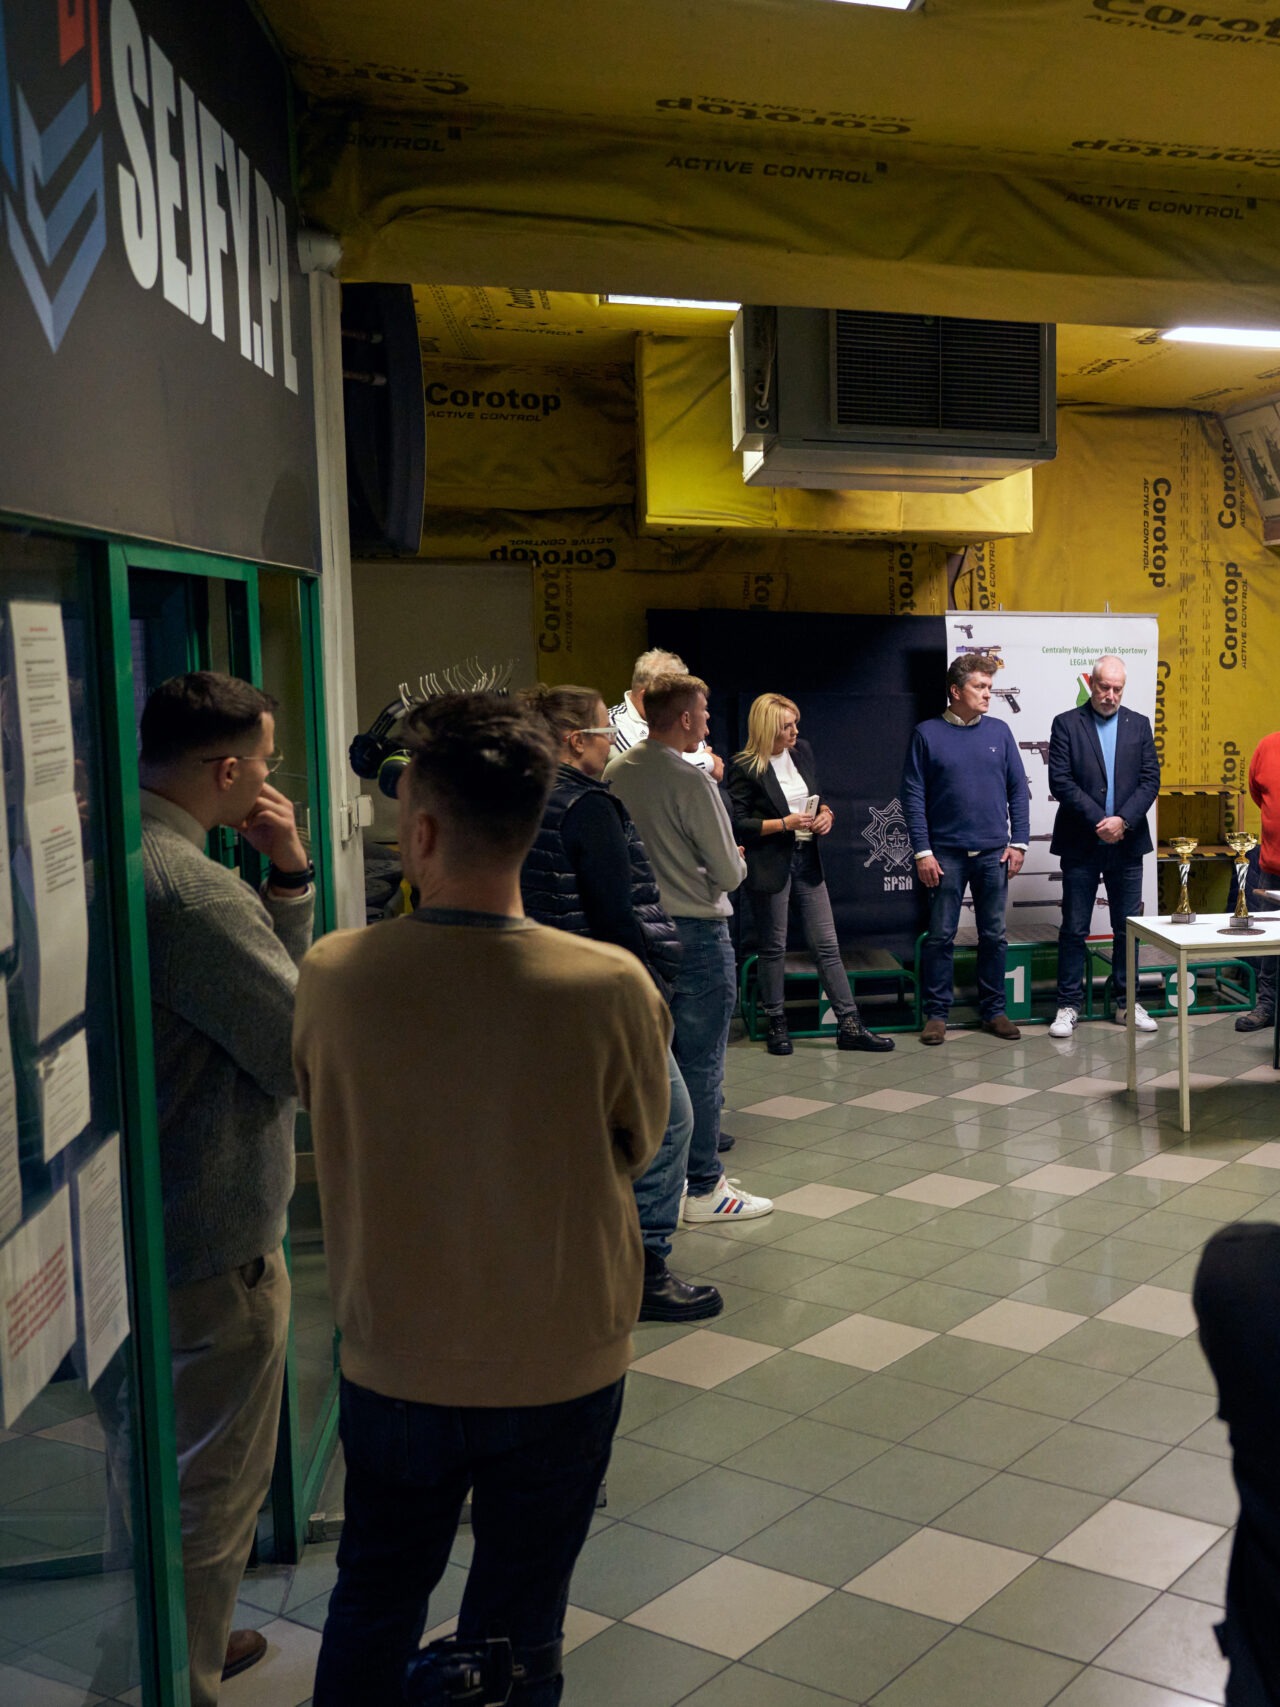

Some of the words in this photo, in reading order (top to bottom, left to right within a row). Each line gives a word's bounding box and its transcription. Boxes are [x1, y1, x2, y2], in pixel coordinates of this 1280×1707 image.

[654, 97, 912, 135] Corotop
[665, 156, 755, 175] ACTIVE
[762, 163, 875, 185] CONTROL
[110, 0, 299, 395] SEJFY.PL
[1147, 200, 1246, 221] CONTROL
[425, 381, 562, 417] Corotop
[427, 410, 476, 420] ACTIVE
[479, 411, 544, 423] CONTROL
[1217, 438, 1238, 530] Coroto
[571, 537, 615, 547] ACTIVE
[1148, 477, 1172, 589] Corotop
[897, 541, 917, 616] orot
[988, 541, 997, 588] CONTRO
[538, 569, 562, 654] Corot
[1219, 562, 1243, 671] Corotop
[1240, 578, 1249, 629] CONTROL
[564, 611, 574, 654] ACTIVE
[1240, 631, 1248, 670] ACTIVE
[1042, 647, 1071, 656] Centralny
[1073, 647, 1103, 656] Wojskowy
[1118, 648, 1148, 657] Sportowy
[1070, 659, 1087, 667] LEGIA
[884, 875, 913, 891] SPSA
[1004, 965, 1026, 1003] 1
[1167, 971, 1196, 1008] 3
